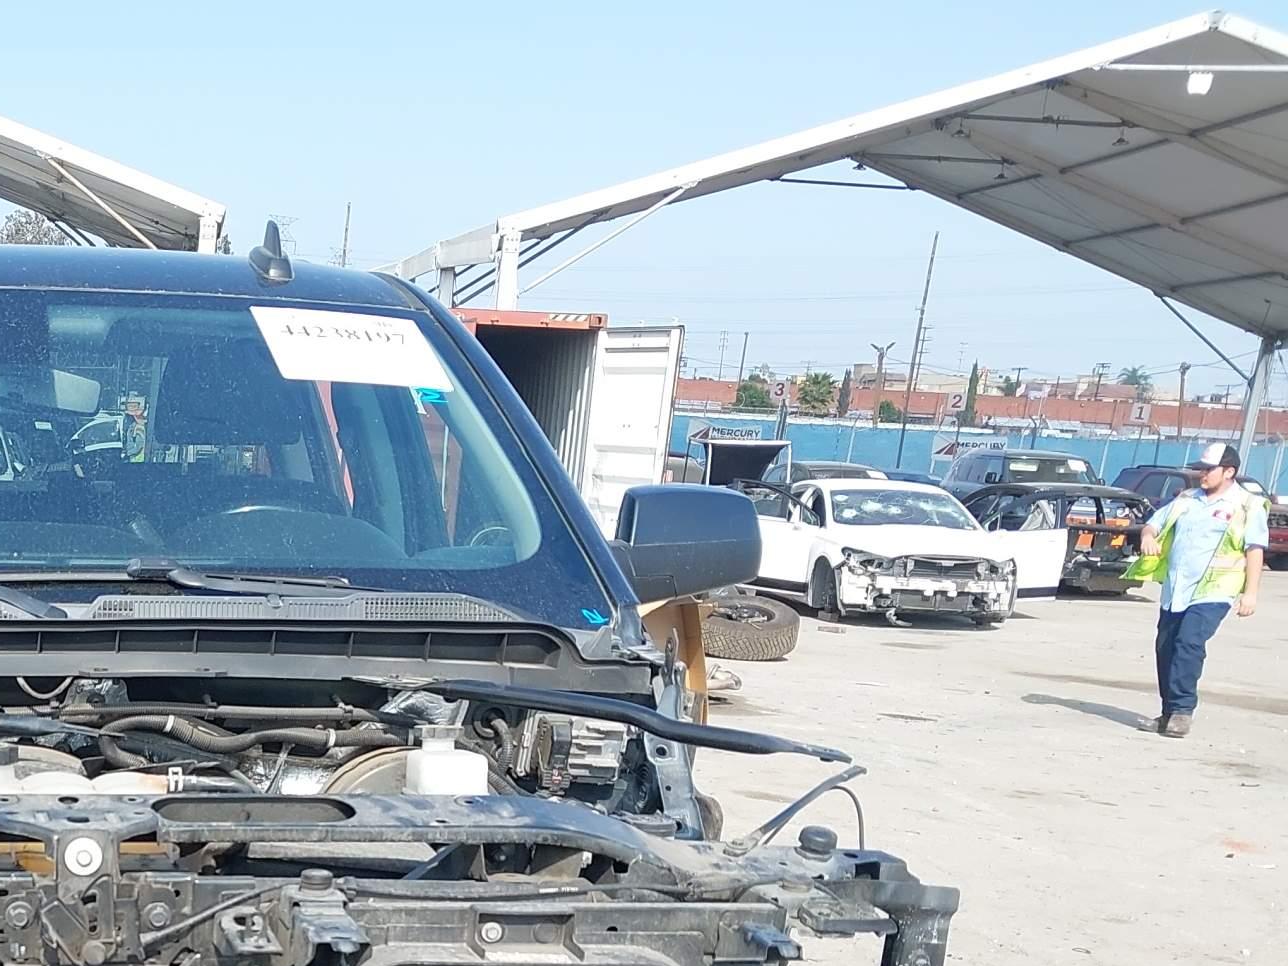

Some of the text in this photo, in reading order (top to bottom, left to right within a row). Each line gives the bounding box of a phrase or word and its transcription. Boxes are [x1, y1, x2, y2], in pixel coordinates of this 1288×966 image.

[280, 324, 405, 345] 44238197
[774, 382, 785, 397] 3
[951, 394, 963, 409] 2
[1135, 405, 1145, 420] 1
[711, 426, 761, 438] MERCURY
